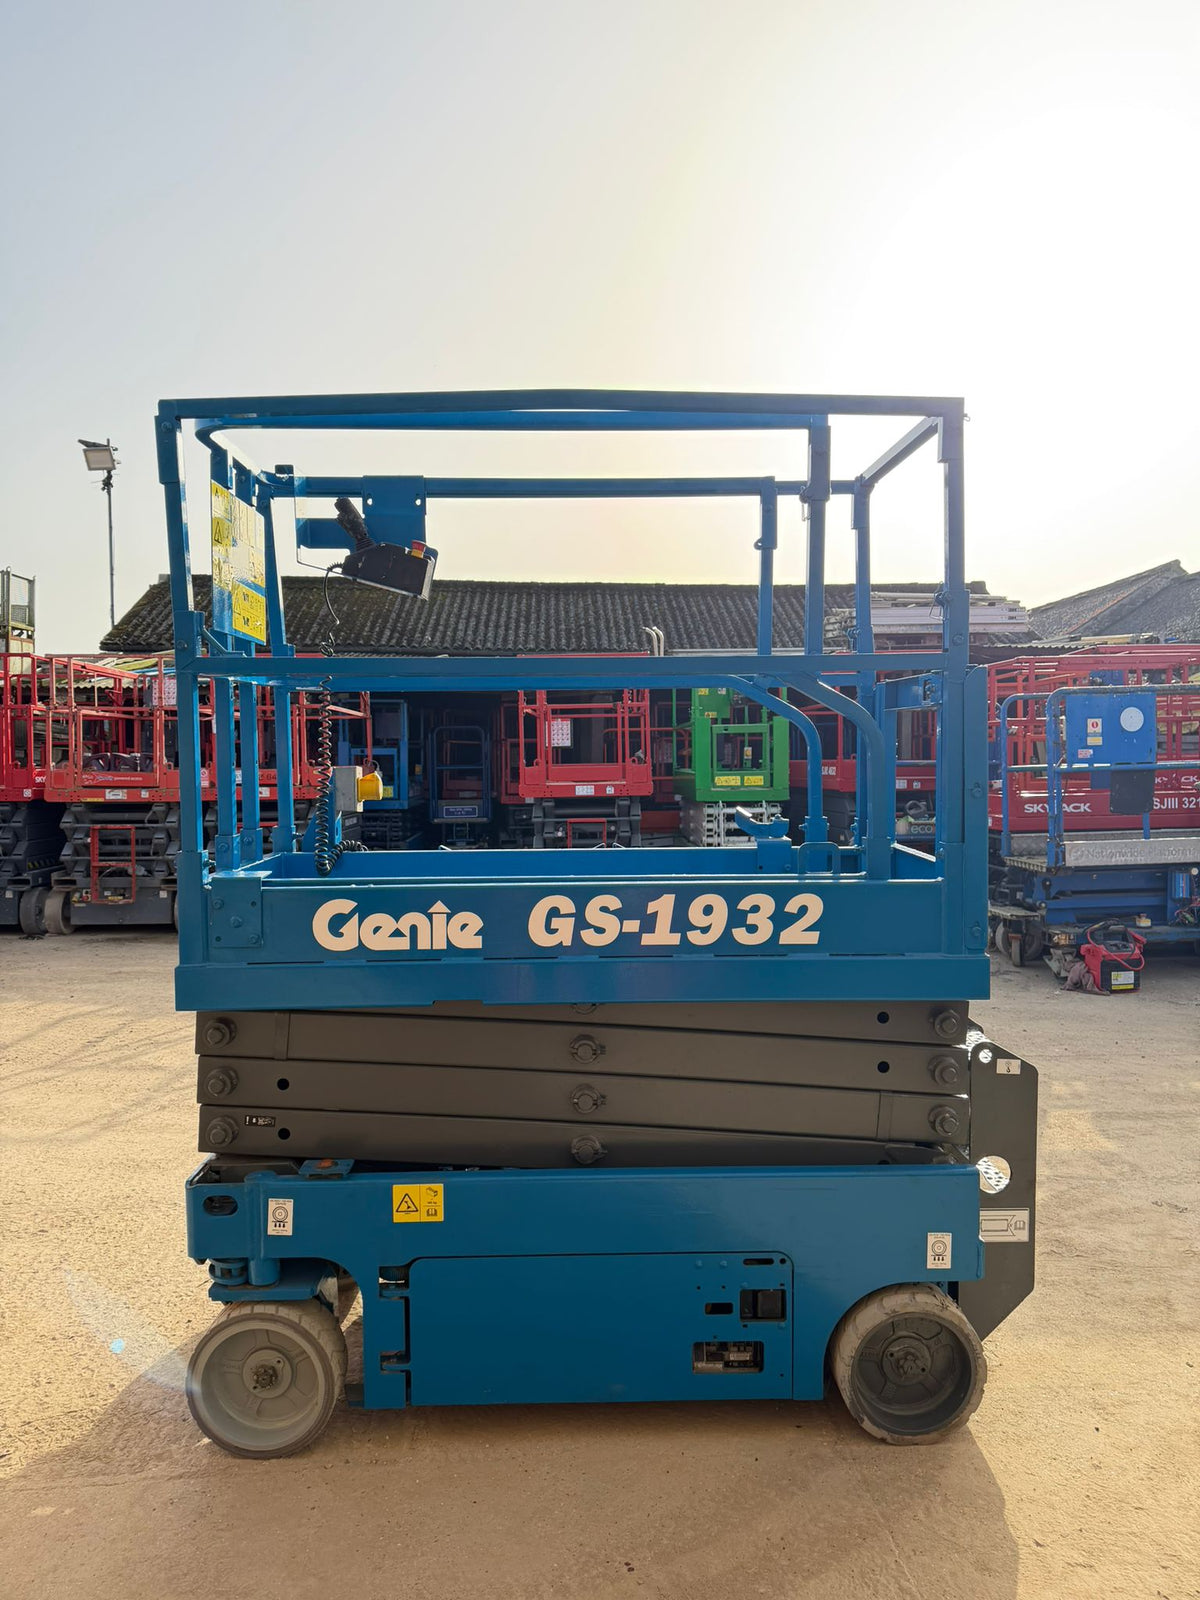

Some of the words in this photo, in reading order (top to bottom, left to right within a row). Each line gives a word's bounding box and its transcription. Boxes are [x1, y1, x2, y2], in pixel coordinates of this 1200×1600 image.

[1024, 802, 1092, 813] SKYACK
[1152, 797, 1178, 810] SJIII
[910, 825, 933, 834] eco
[312, 899, 484, 952] Genie
[528, 892, 824, 948] GS-1932
